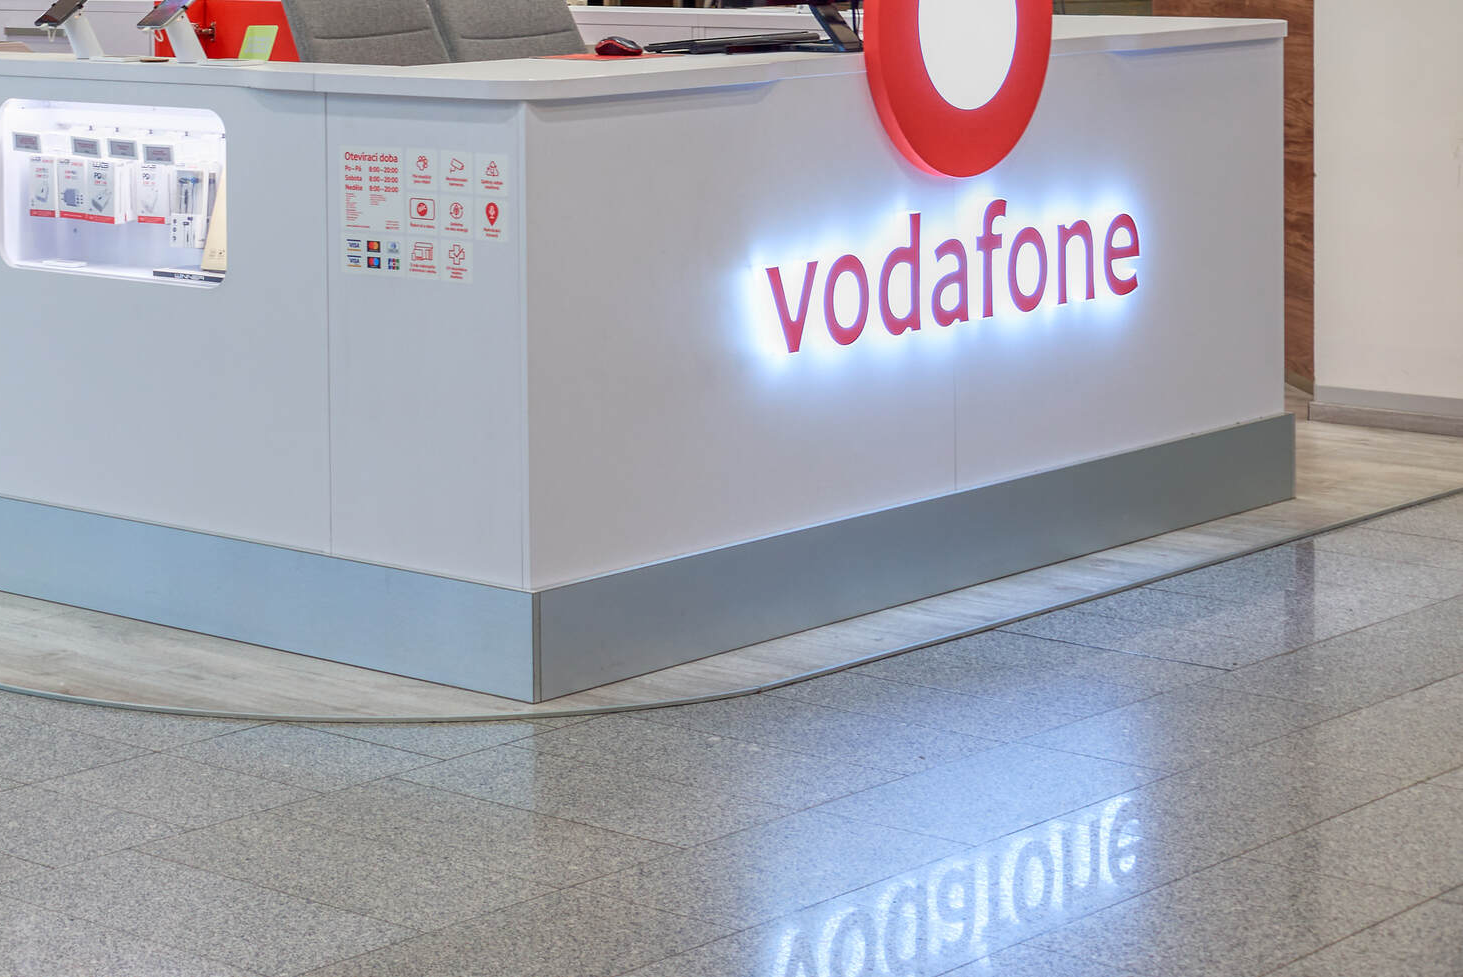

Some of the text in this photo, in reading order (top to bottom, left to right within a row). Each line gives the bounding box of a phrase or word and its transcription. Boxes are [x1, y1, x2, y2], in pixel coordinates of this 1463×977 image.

[345, 151, 398, 163] Otevírací doba
[765, 198, 1142, 354] vodafone
